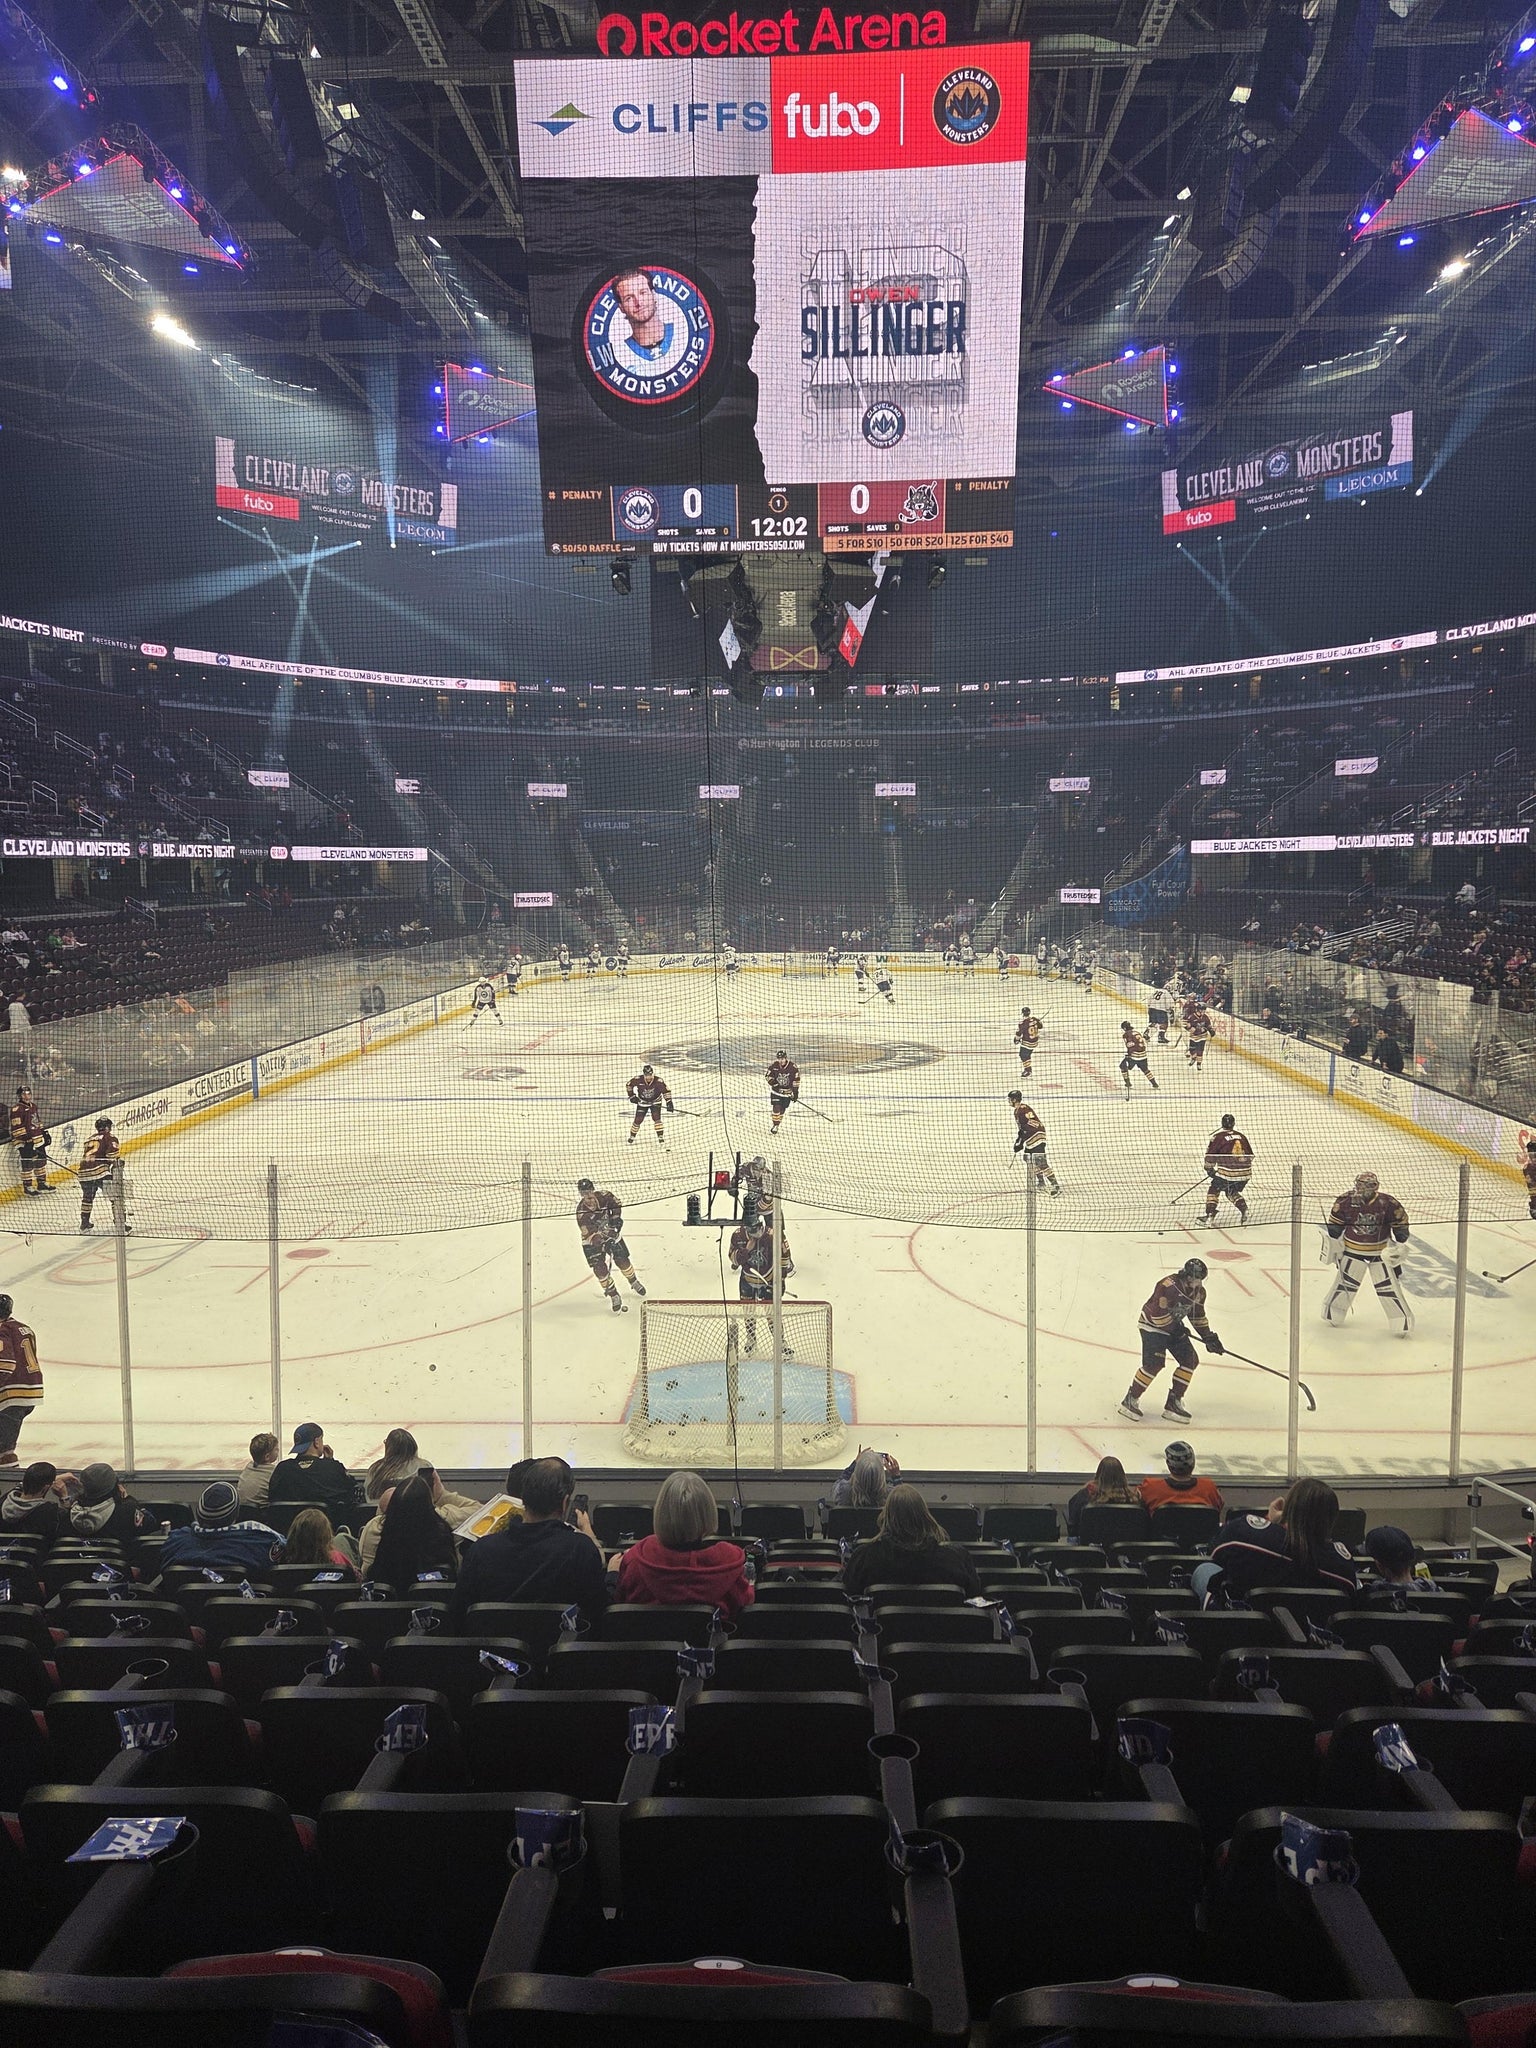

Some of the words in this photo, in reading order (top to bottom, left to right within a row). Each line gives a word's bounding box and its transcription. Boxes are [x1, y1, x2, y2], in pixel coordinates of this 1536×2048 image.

[641, 10, 800, 57] Rocket
[808, 7, 947, 51] Arena
[942, 70, 993, 93] CLEVELAND
[612, 101, 769, 134] CLIFFS
[783, 91, 881, 139] fubo
[942, 121, 990, 142] MONSTERS
[849, 284, 920, 304] OWEN
[687, 306, 709, 332] 12
[800, 300, 967, 360] SILLINGER
[588, 342, 615, 372] LW
[608, 336, 706, 395] MONSTERS
[1186, 459, 1264, 502] CLEVELAND
[1297, 431, 1383, 478] MONSTERS
[245, 455, 330, 497] CLEVELAND
[361, 478, 434, 516] MONSTERS
[562, 490, 603, 500] PENALTY
[968, 480, 1010, 491] PENALTY
[243, 494, 274, 513] fubo
[683, 487, 703, 519] 0
[850, 483, 870, 515] 0
[751, 517, 808, 537] 12:02
[827, 525, 849, 533] SHOTS
[866, 523, 887, 532] SAVES
[1186, 511, 1213, 526] fubo
[657, 528, 679, 536] SHOTS
[695, 528, 716, 536] SAVES
[722, 527, 729, 536] 0
[889, 538, 902, 547] 50
[904, 537, 923, 547] FOR
[925, 536, 944, 547] $20
[950, 536, 967, 546] 125
[969, 535, 987, 545] FOR
[990, 535, 1009, 544] $40
[562, 543, 588, 553] 50/50
[589, 543, 621, 553] RAFFLE
[653, 542, 669, 552] BUY
[670, 542, 700, 552] TICKETS
[720, 541, 729, 550] AT
[730, 539, 805, 551] MONSTERS5050.COM
[838, 540, 844, 549] 5
[846, 539, 865, 548] FOR
[867, 538, 884, 548] $10
[0, 615, 50, 636] JACKETS
[52, 626, 84, 643] NIGHT
[1446, 617, 1516, 640] CLEVELAND
[92, 636, 128, 649] PRESENTED
[1168, 669, 1186, 677] AHL
[1189, 664, 1233, 675] AFFILIATE
[1235, 661, 1246, 669] OF
[1249, 659, 1265, 668] THE
[1267, 653, 1314, 666] COLUMBUS
[1316, 649, 1339, 660] BLUE
[1341, 644, 1381, 657] JACKETS
[240, 659, 257, 669] AHL
[259, 662, 303, 674] AFFILIATE
[304, 667, 317, 675] OF
[319, 668, 336, 677] THE
[338, 671, 382, 682] COLUMBUS
[384, 676, 405, 684] BLUE
[407, 677, 446, 687] JACKETS
[809, 739, 852, 748] LEGENDS
[854, 738, 880, 748] CLUB
[1213, 840, 1236, 851] BLUE
[1238, 839, 1278, 850] JACKETS
[1279, 838, 1302, 849] NIGHT
[1338, 835, 1376, 848] CLEVELAND
[1376, 833, 1414, 847] MONSTERS
[1432, 831, 1454, 846] BLUE
[1456, 829, 1497, 845] JACKETS
[1499, 827, 1530, 844] NIGHT
[3, 839, 74, 857] CLEVELAND
[76, 840, 131, 857] MONSTERS
[153, 843, 175, 858] BLUE
[177, 844, 212, 858] JACKETS
[213, 845, 235, 858] NIGHT
[321, 850, 367, 859] CLEVELAND
[369, 850, 414, 860] MONSTERS
[195, 1071, 232, 1098] CENTER
[233, 1065, 247, 1084] ICE
